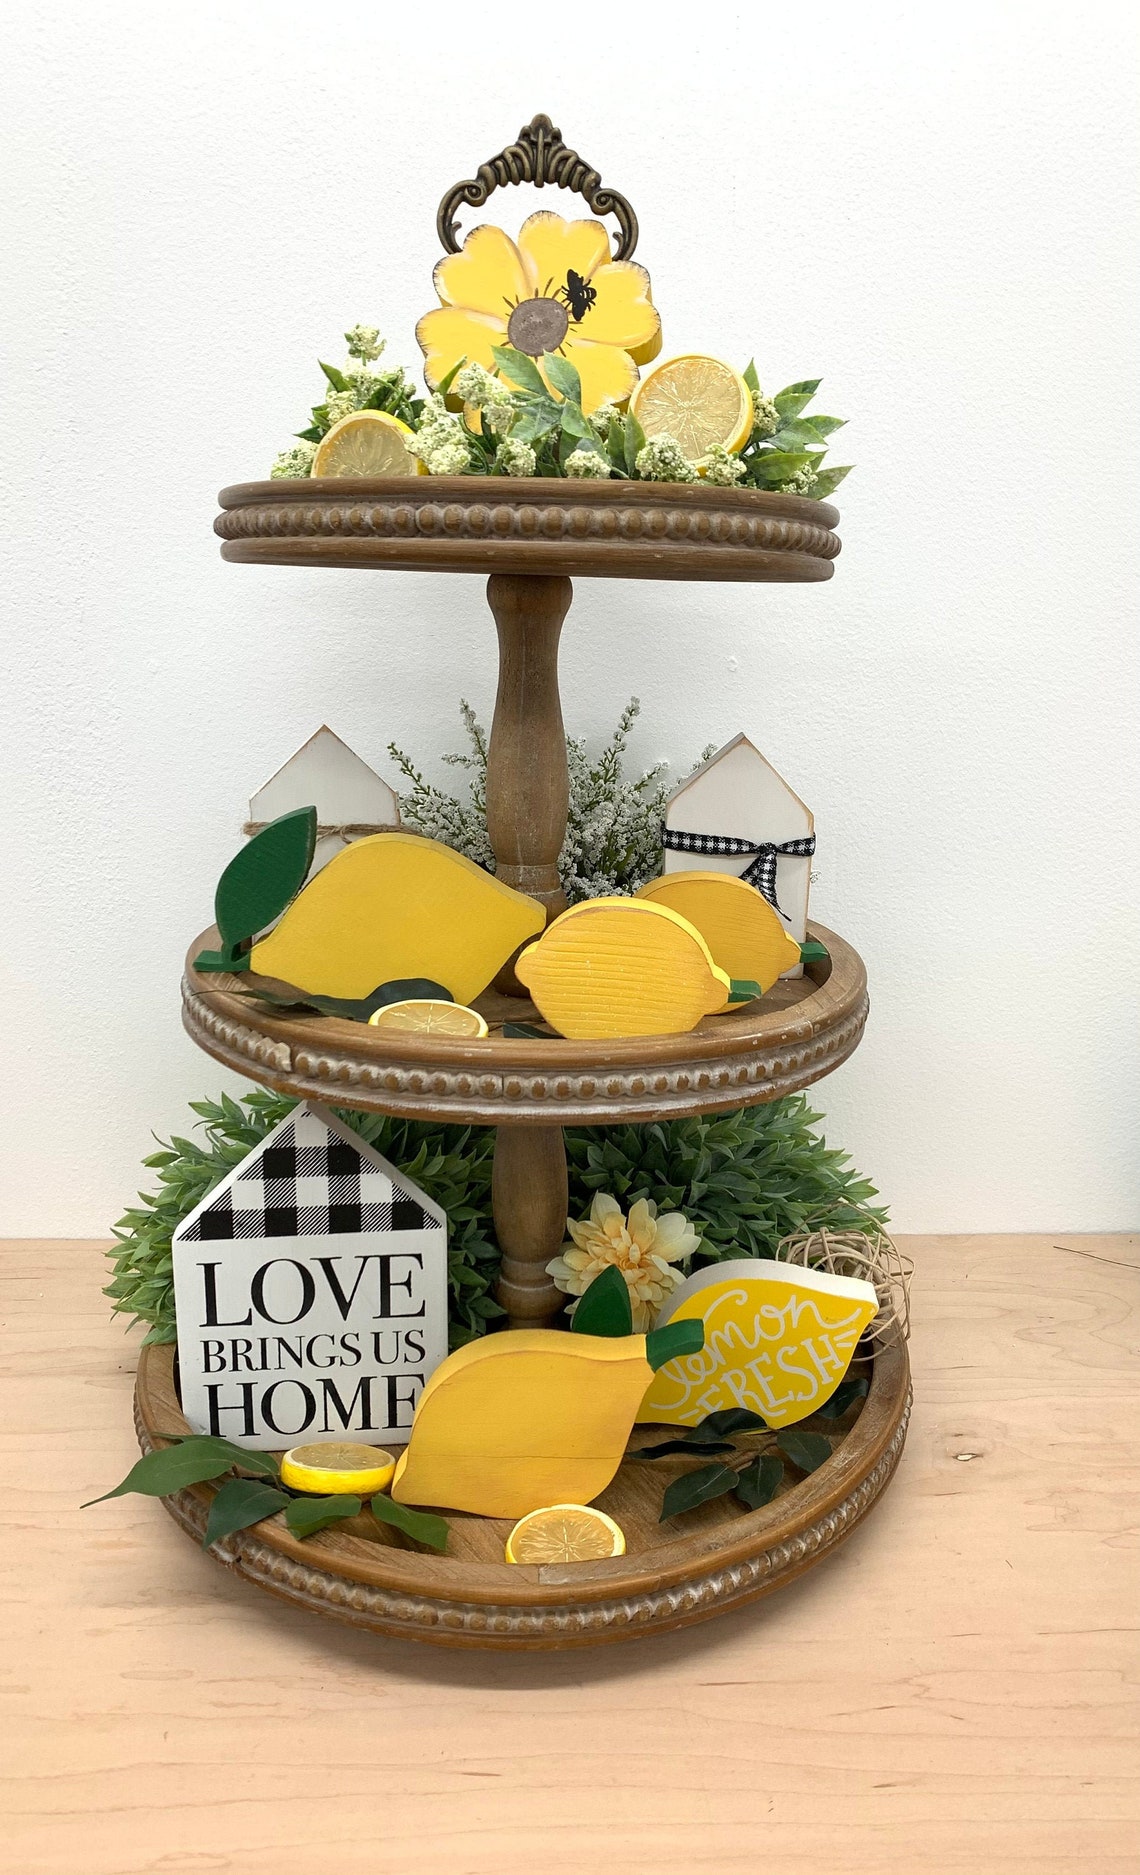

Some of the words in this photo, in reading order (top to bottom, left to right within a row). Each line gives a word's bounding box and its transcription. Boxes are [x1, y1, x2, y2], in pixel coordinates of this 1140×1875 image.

[196, 1253, 426, 1328] LOVE
[200, 1332, 363, 1374] BRINGS
[370, 1329, 427, 1366] US
[650, 1288, 863, 1410] lemon
[694, 1334, 846, 1418] FRESH
[203, 1373, 426, 1438] HOME
